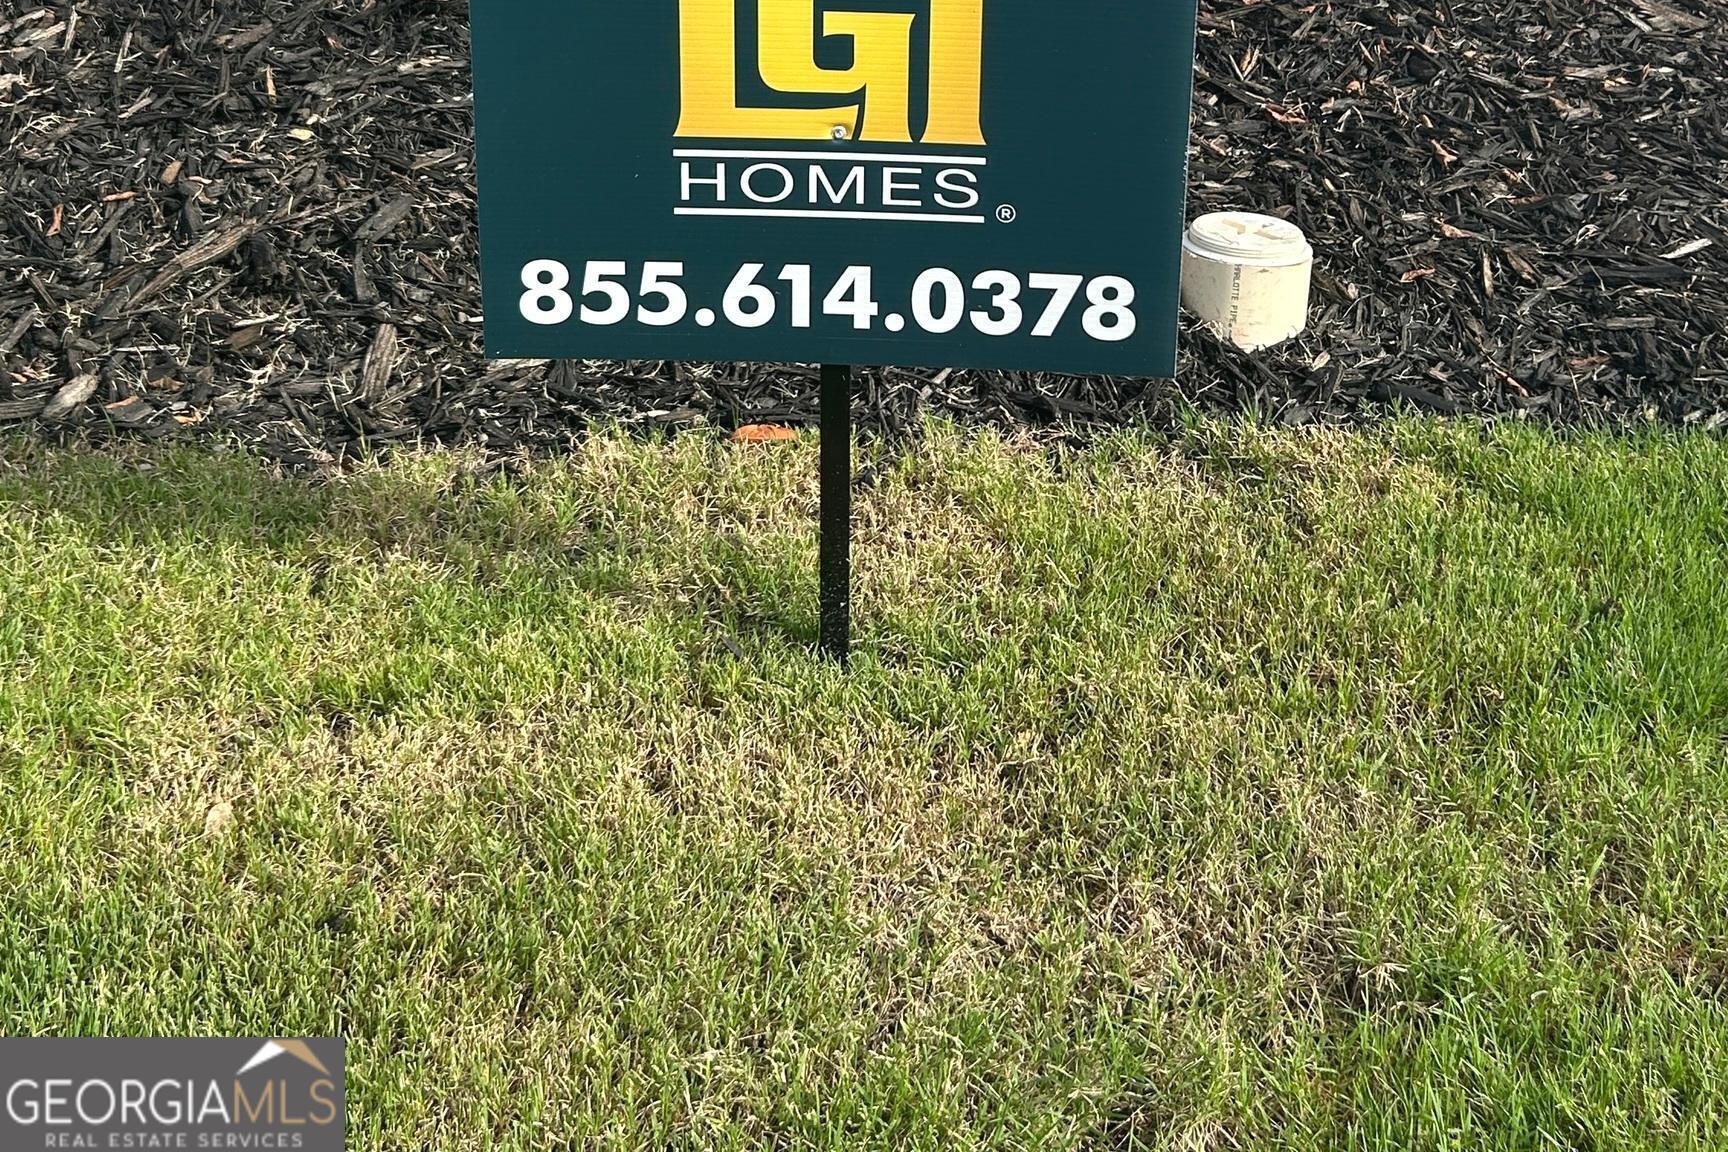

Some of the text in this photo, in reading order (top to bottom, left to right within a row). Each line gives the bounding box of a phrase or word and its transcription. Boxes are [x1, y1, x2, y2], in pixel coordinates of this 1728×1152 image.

[680, 162, 979, 209] HOMES
[519, 259, 1136, 341] 855.614.0378
[1231, 263, 1242, 301] HARLOTTE
